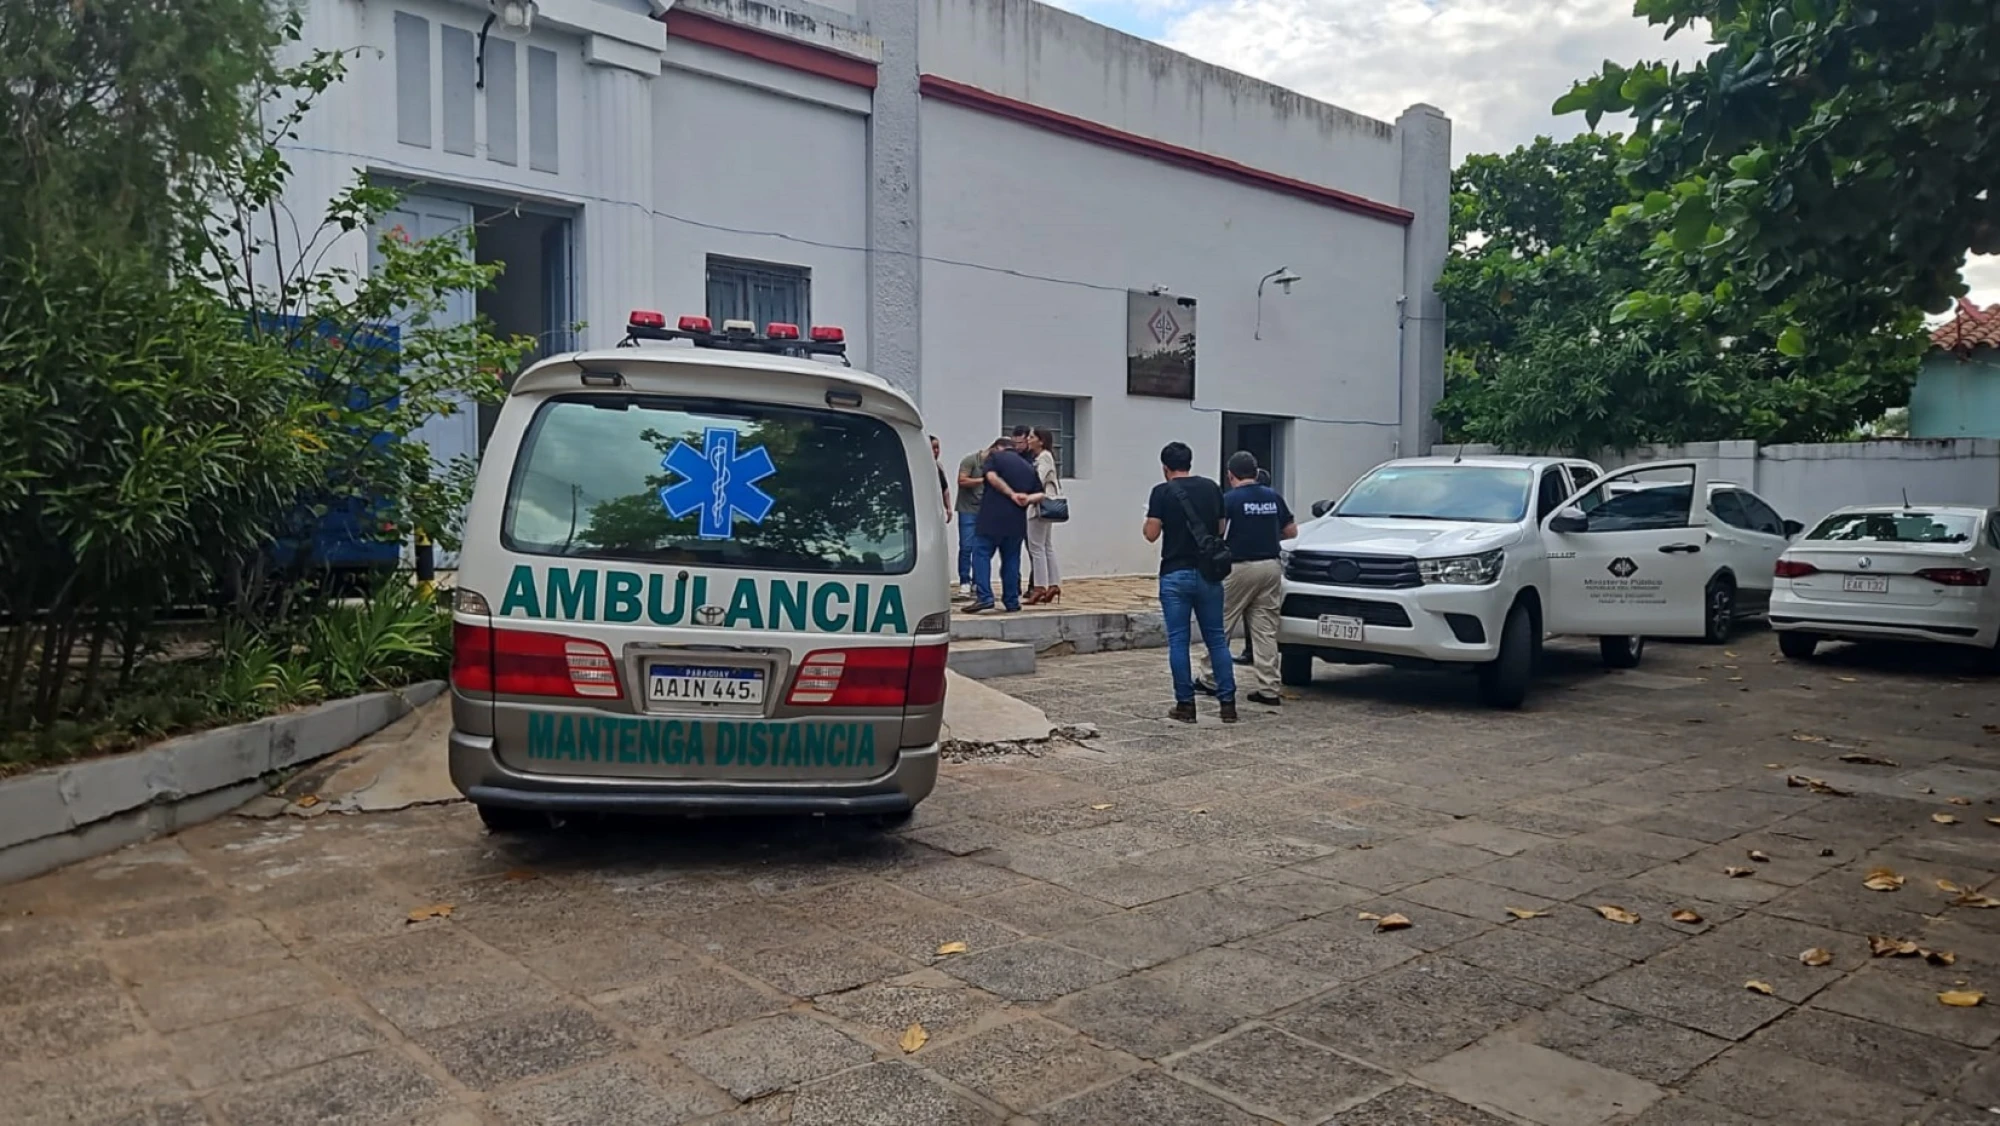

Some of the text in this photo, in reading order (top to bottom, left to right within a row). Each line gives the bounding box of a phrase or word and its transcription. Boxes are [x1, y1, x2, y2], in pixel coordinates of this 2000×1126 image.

[499, 564, 908, 634] AMBULANCIA
[1343, 625, 1359, 639] 197
[685, 668, 730, 678] PARAGUAY
[653, 678, 751, 700] AAIN 445
[527, 711, 876, 767] MANTENGA DISTANCIA
